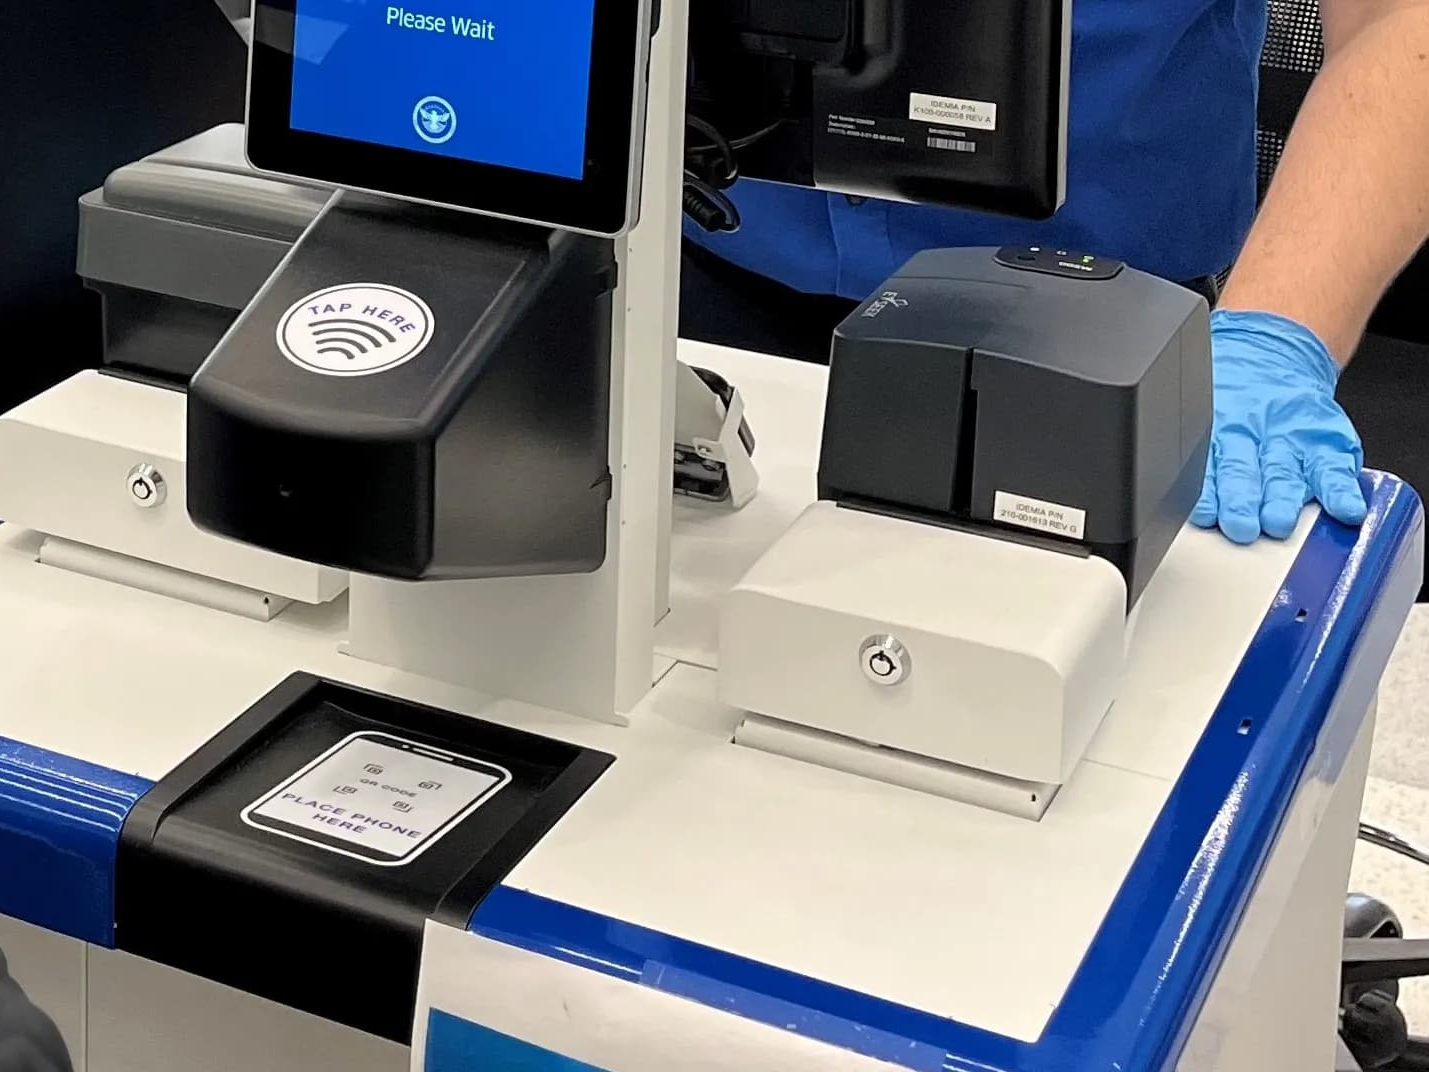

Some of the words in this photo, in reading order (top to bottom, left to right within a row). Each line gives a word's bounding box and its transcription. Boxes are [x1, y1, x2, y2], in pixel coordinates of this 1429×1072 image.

[386, 6, 446, 33] Please
[451, 15, 495, 40] Wait
[308, 303, 352, 316] TAP
[361, 305, 416, 333] HERE
[381, 784, 418, 797] CODE
[281, 792, 348, 816] PLACE
[350, 812, 423, 839] PHONE
[312, 813, 368, 834] HERE
